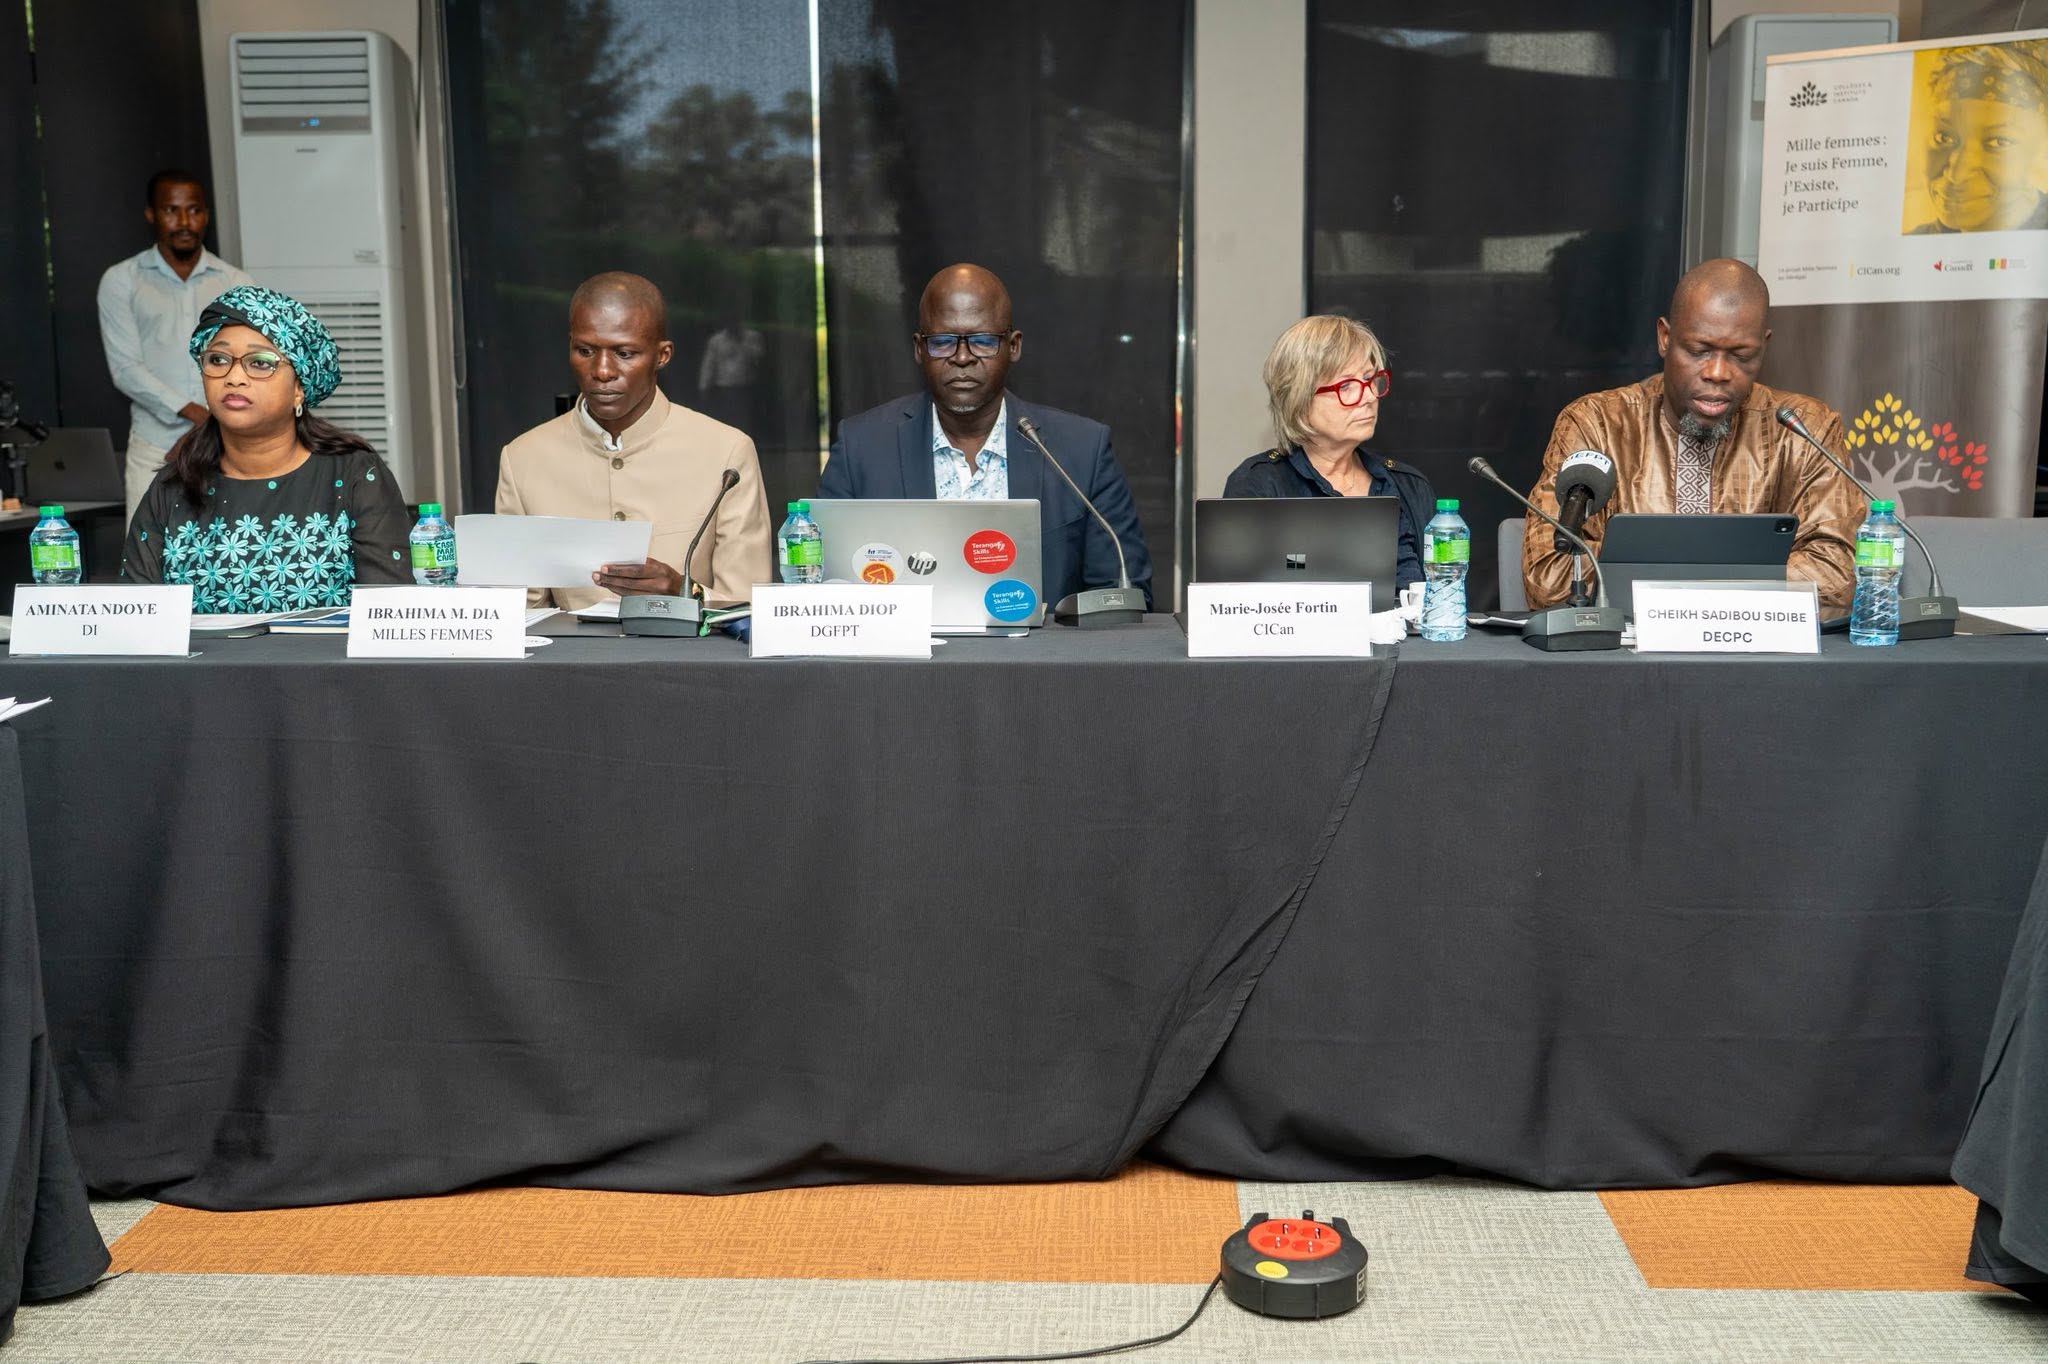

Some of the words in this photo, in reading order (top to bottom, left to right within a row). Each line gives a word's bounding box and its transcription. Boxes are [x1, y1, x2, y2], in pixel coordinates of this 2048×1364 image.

[1786, 138, 1821, 152] Mille
[1800, 158, 1828, 171] suis
[1832, 156, 1888, 169] Femme,
[1798, 197, 1859, 213] Participe
[1856, 266, 1901, 277] CICan.org
[910, 551, 936, 575] hp
[992, 591, 1018, 599] Teranga
[26, 604, 97, 616] AMINATA
[102, 603, 157, 615] NDOYE
[368, 608, 446, 619] IBRAHIMA
[451, 608, 468, 619] M.
[473, 608, 499, 619] DIA
[775, 605, 854, 617] IBRAHIMA
[860, 604, 898, 615] DIOP
[1210, 602, 1291, 615] Marie-Josée
[1296, 602, 1338, 613] Fortin
[1648, 609, 1698, 620] CHEIKH
[1702, 610, 1761, 621] SADIBOU
[1764, 611, 1807, 622] SIDIBE
[83, 625, 97, 636] DI
[373, 628, 426, 640] MILLES
[431, 628, 493, 640] FEMMES
[811, 625, 860, 637] DGFPT
[1254, 624, 1295, 635] CICan
[1703, 631, 1753, 643] DECPC
